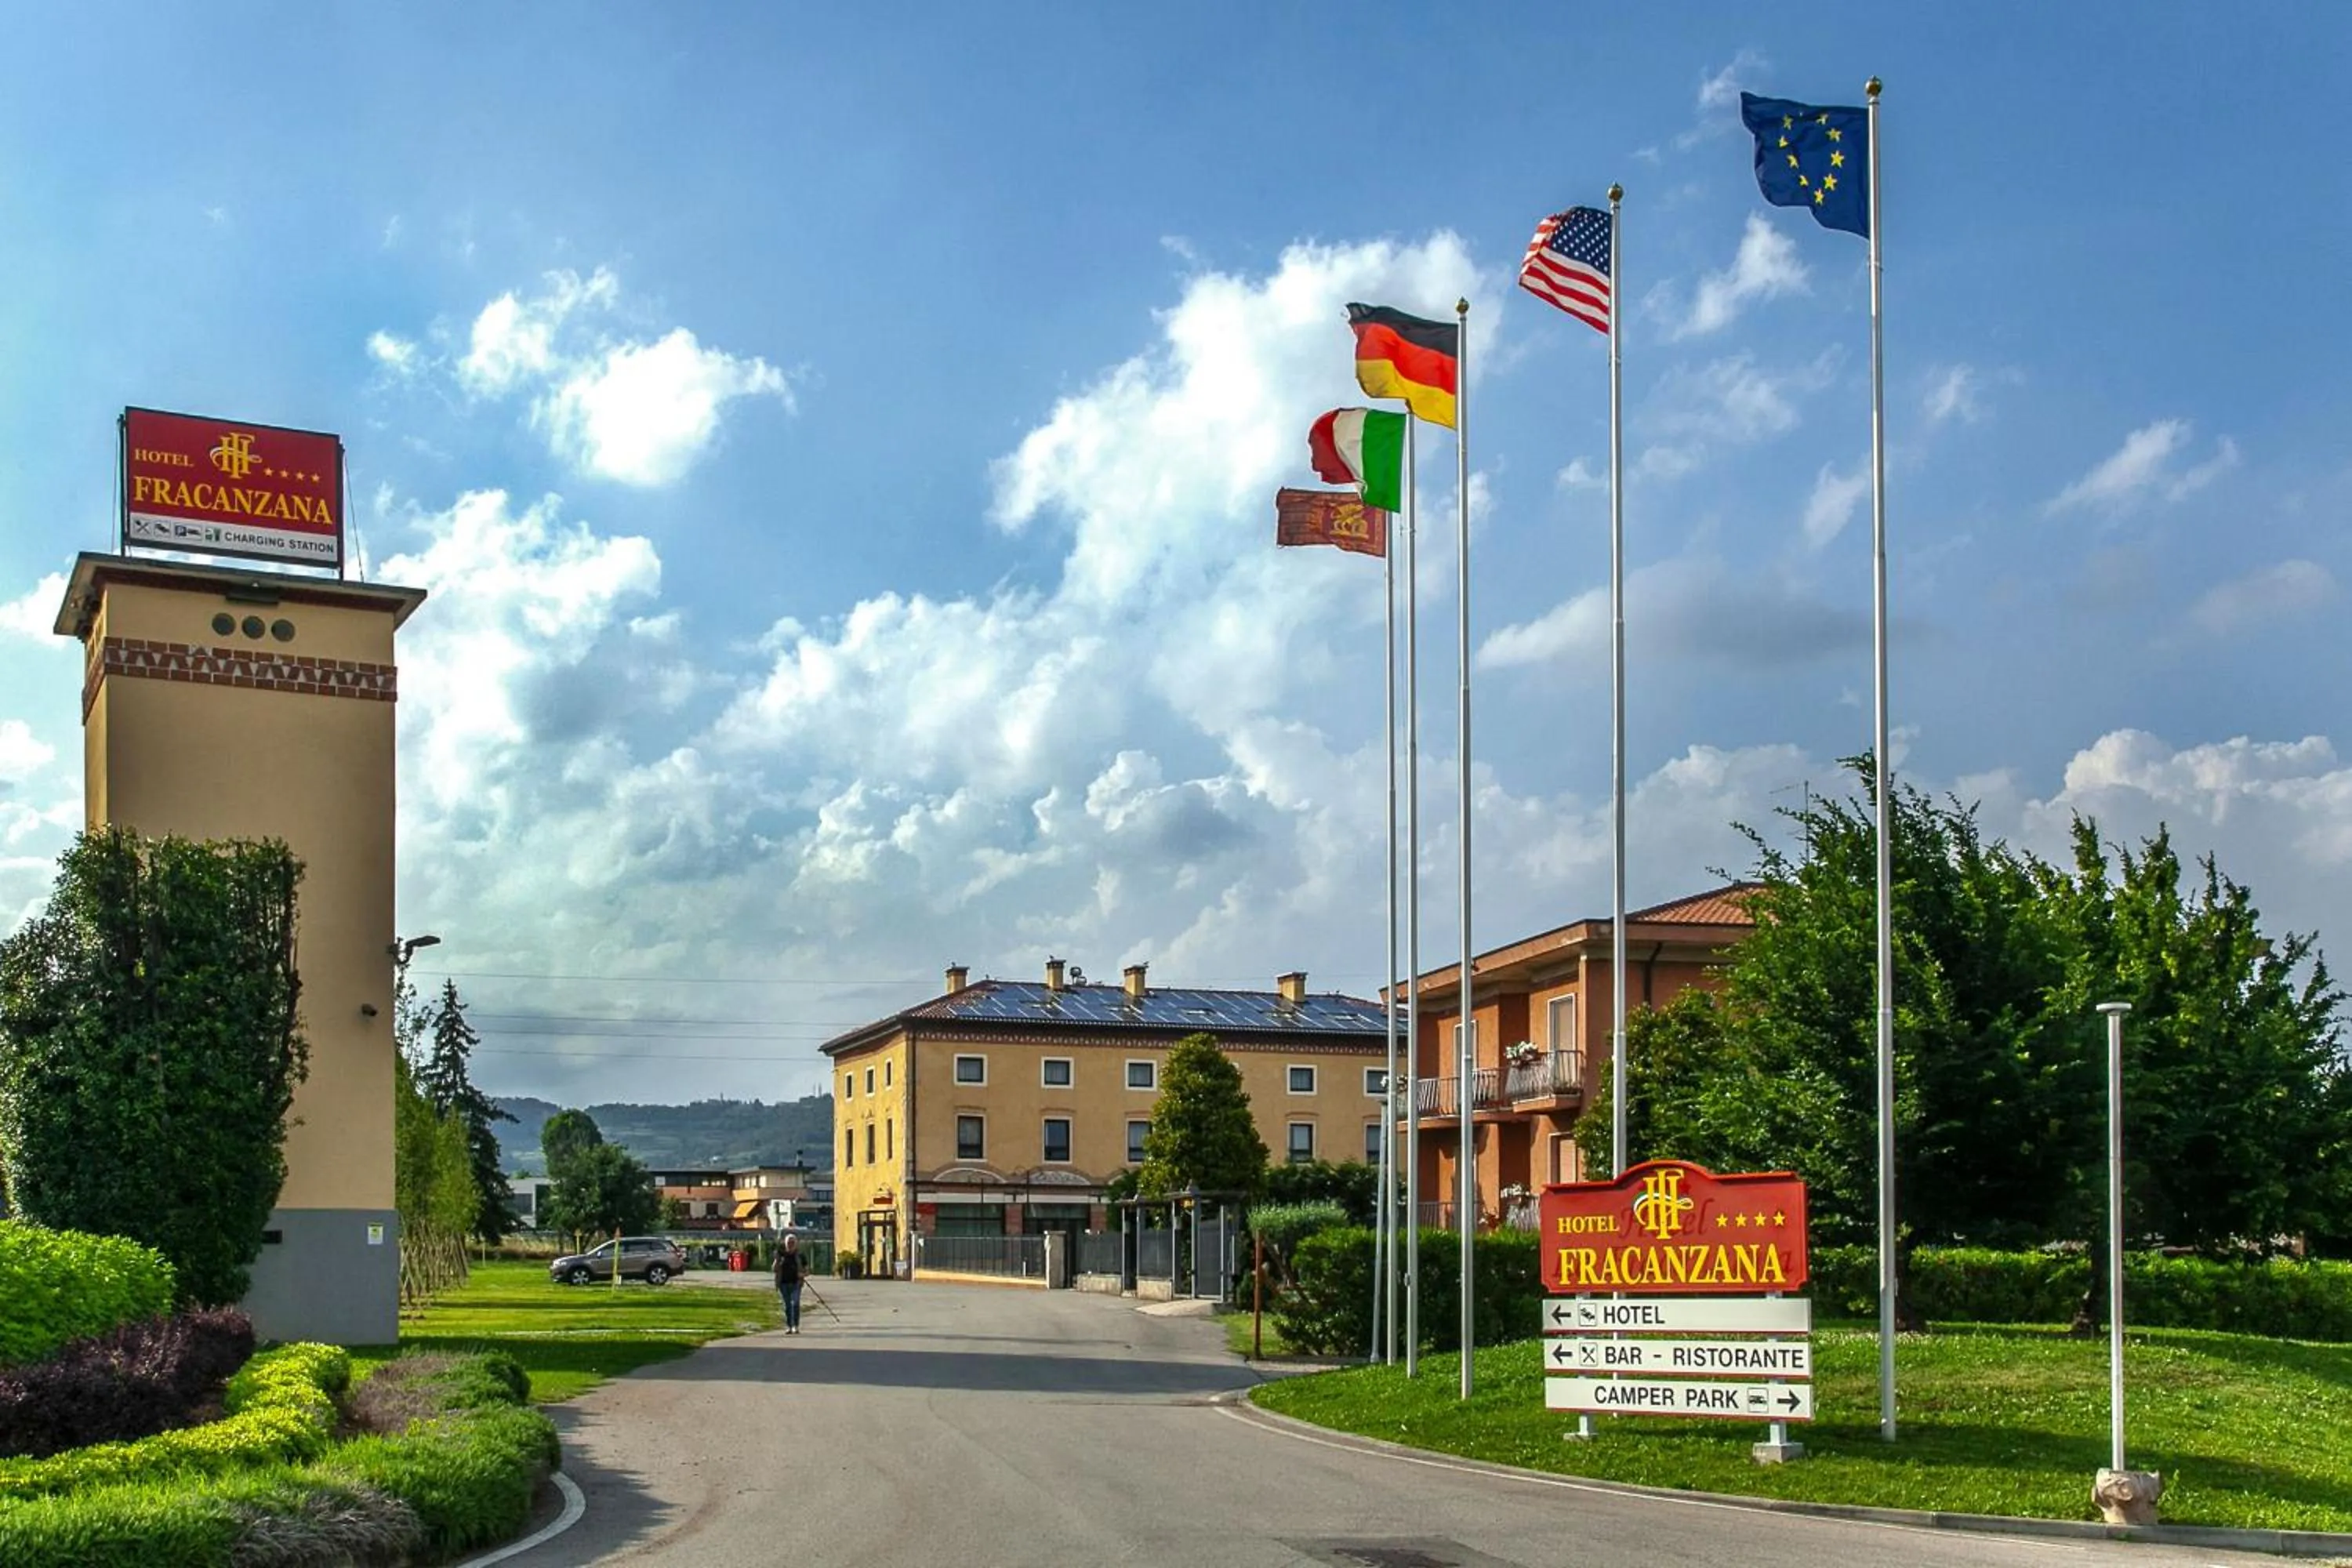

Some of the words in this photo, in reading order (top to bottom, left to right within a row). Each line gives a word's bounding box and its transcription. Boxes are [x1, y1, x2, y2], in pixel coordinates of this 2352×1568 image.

[134, 448, 194, 467] HOTEL
[133, 476, 333, 525] FRACANZANA
[224, 532, 285, 548] CHARGING
[289, 539, 334, 553] STATION
[1557, 1215, 1619, 1233] HOTEL
[1559, 1243, 1786, 1286] FRACANZANA
[1603, 1305, 1665, 1324] HOTEL
[1605, 1346, 1642, 1365] BAR
[1673, 1348, 1804, 1368] RISTORANTE
[1595, 1386, 1675, 1406] CAMPER
[1686, 1388, 1739, 1409] PARK
